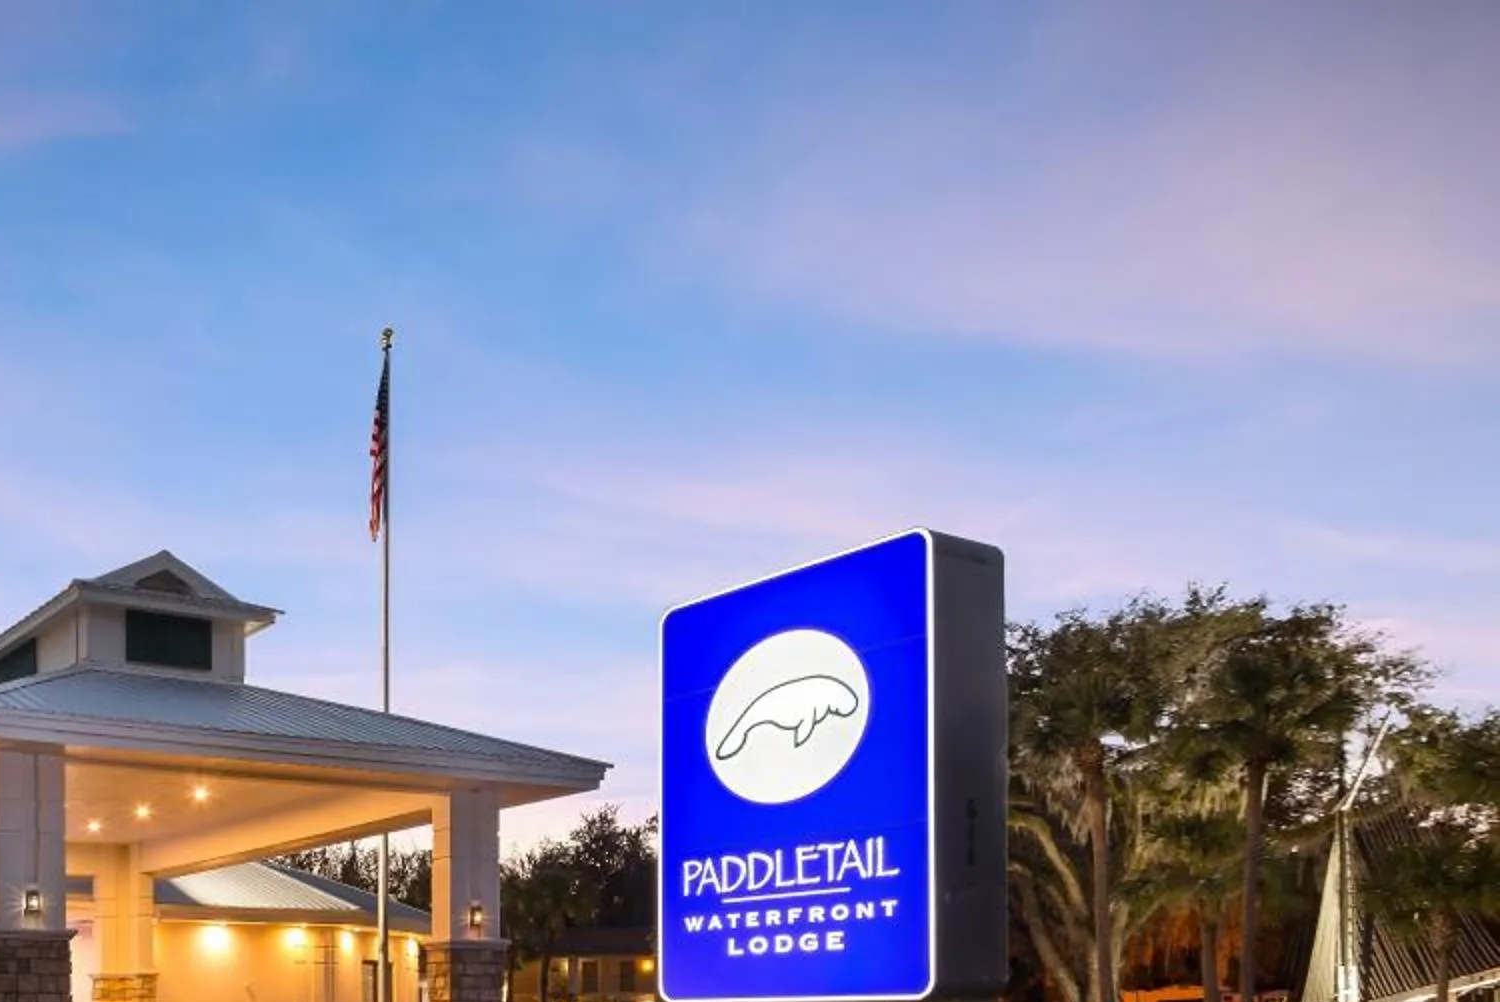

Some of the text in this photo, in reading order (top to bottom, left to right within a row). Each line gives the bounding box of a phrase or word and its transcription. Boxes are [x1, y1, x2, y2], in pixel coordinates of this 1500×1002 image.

[683, 836, 900, 897] PADDLETAIL
[683, 899, 899, 932] WATERFRONT
[727, 931, 845, 956] LODGE
